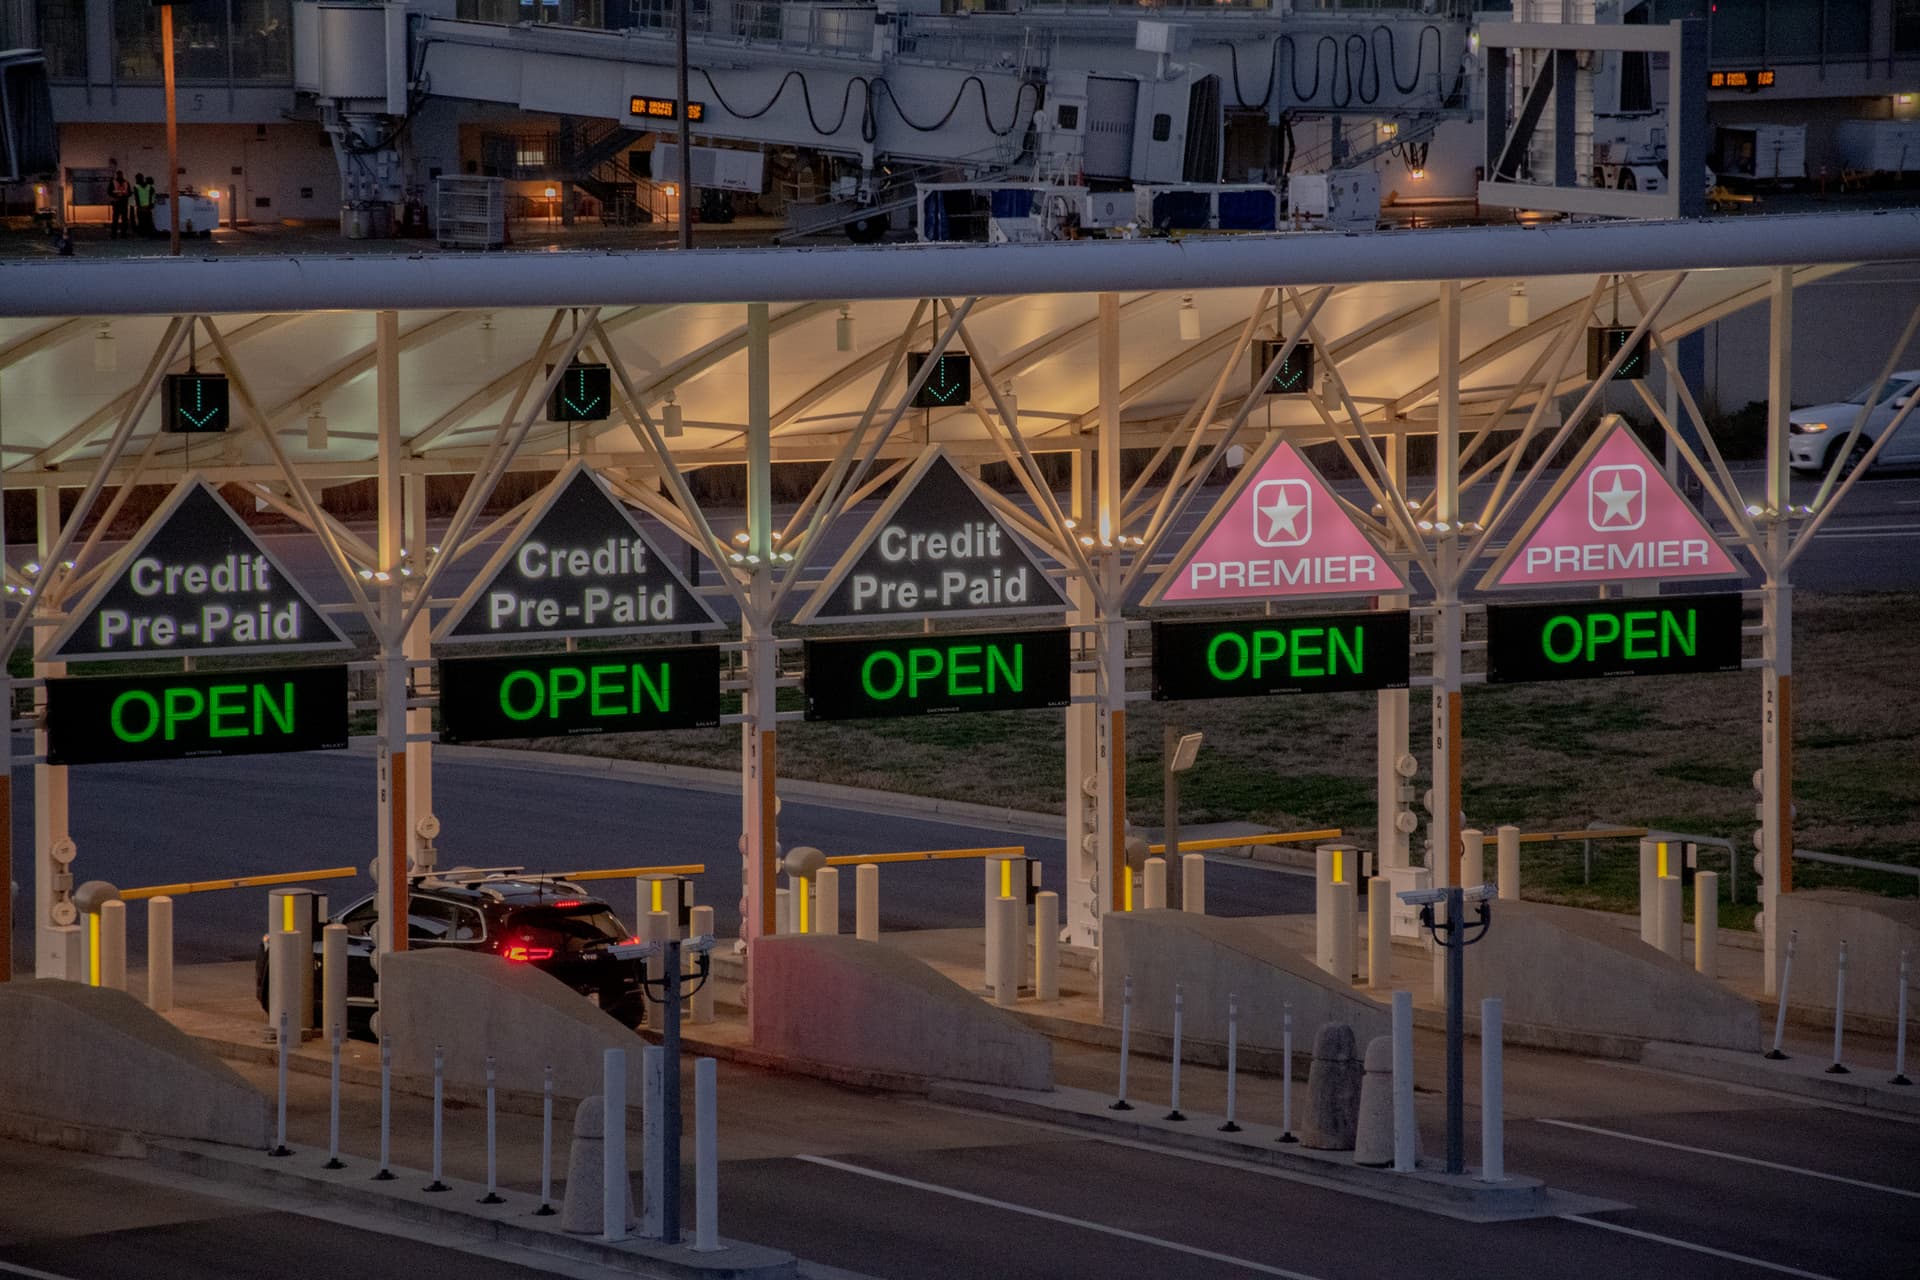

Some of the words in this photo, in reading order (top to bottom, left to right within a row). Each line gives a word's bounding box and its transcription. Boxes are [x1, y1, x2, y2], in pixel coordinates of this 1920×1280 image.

[519, 539, 645, 578] Credit
[880, 523, 1001, 561] Credit
[1528, 539, 1708, 574] PREMIER
[131, 555, 269, 594] Credit
[852, 567, 1027, 611] Pre-Paid
[1191, 555, 1376, 590] PREMIER
[101, 602, 299, 646] Pre-Paid
[489, 586, 674, 629] Pre-Paid
[1207, 626, 1364, 680] OPEN
[1542, 609, 1696, 663] OPEN
[500, 663, 669, 720] OPEN
[862, 643, 1023, 700] OPEN
[111, 682, 294, 742] OPEN
